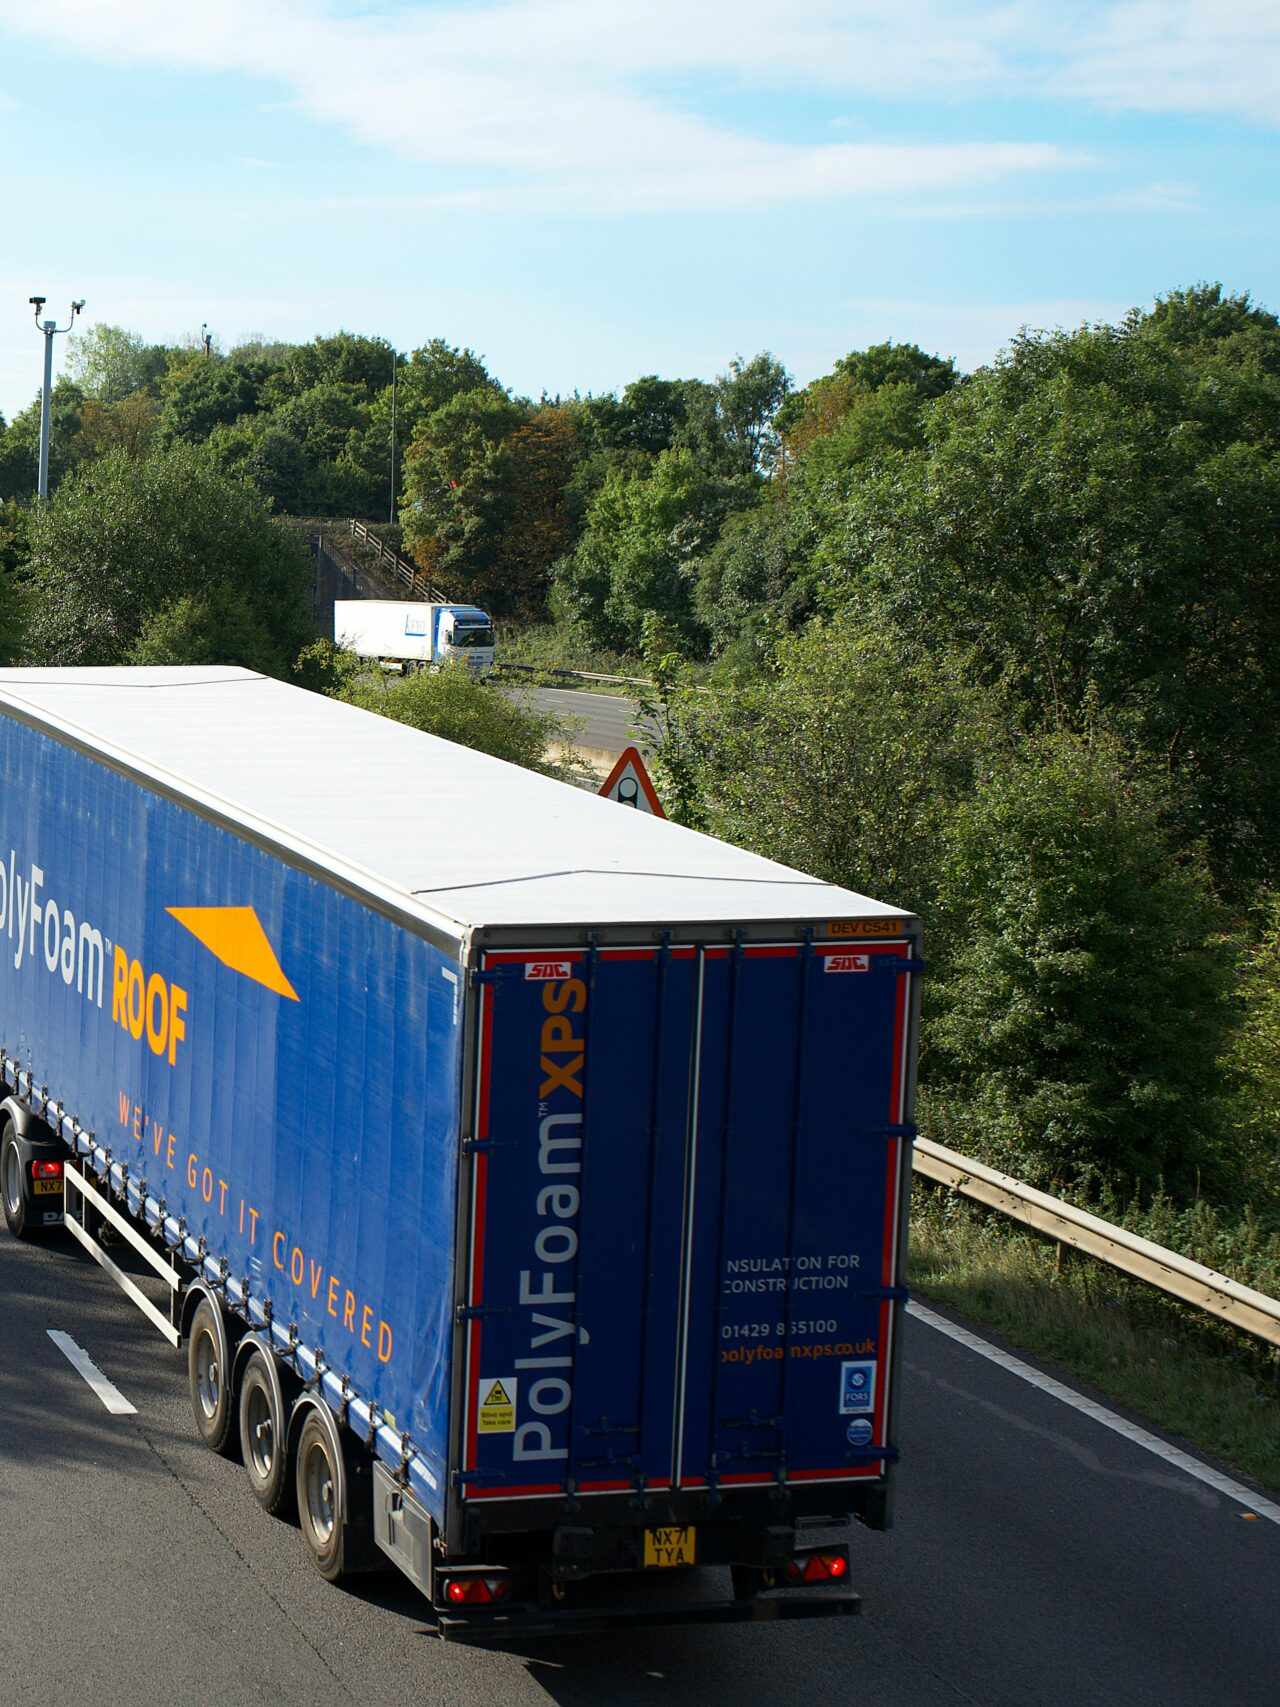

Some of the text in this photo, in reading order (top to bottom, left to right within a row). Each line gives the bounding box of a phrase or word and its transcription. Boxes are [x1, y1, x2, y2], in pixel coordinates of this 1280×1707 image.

[831, 920, 898, 934] DEV C541
[112, 943, 188, 1067] ROOF
[539, 978, 588, 1099] XPS
[41, 1181, 63, 1193] NX7
[119, 1091, 393, 1364] WE'VE GOT IT COVERED
[726, 1254, 860, 1273] NSULATON FOR
[721, 1323, 770, 1339] 01429
[846, 1392, 869, 1401] FORS
[652, 1530, 688, 1546] NX71
[654, 1547, 685, 1563] TYA
